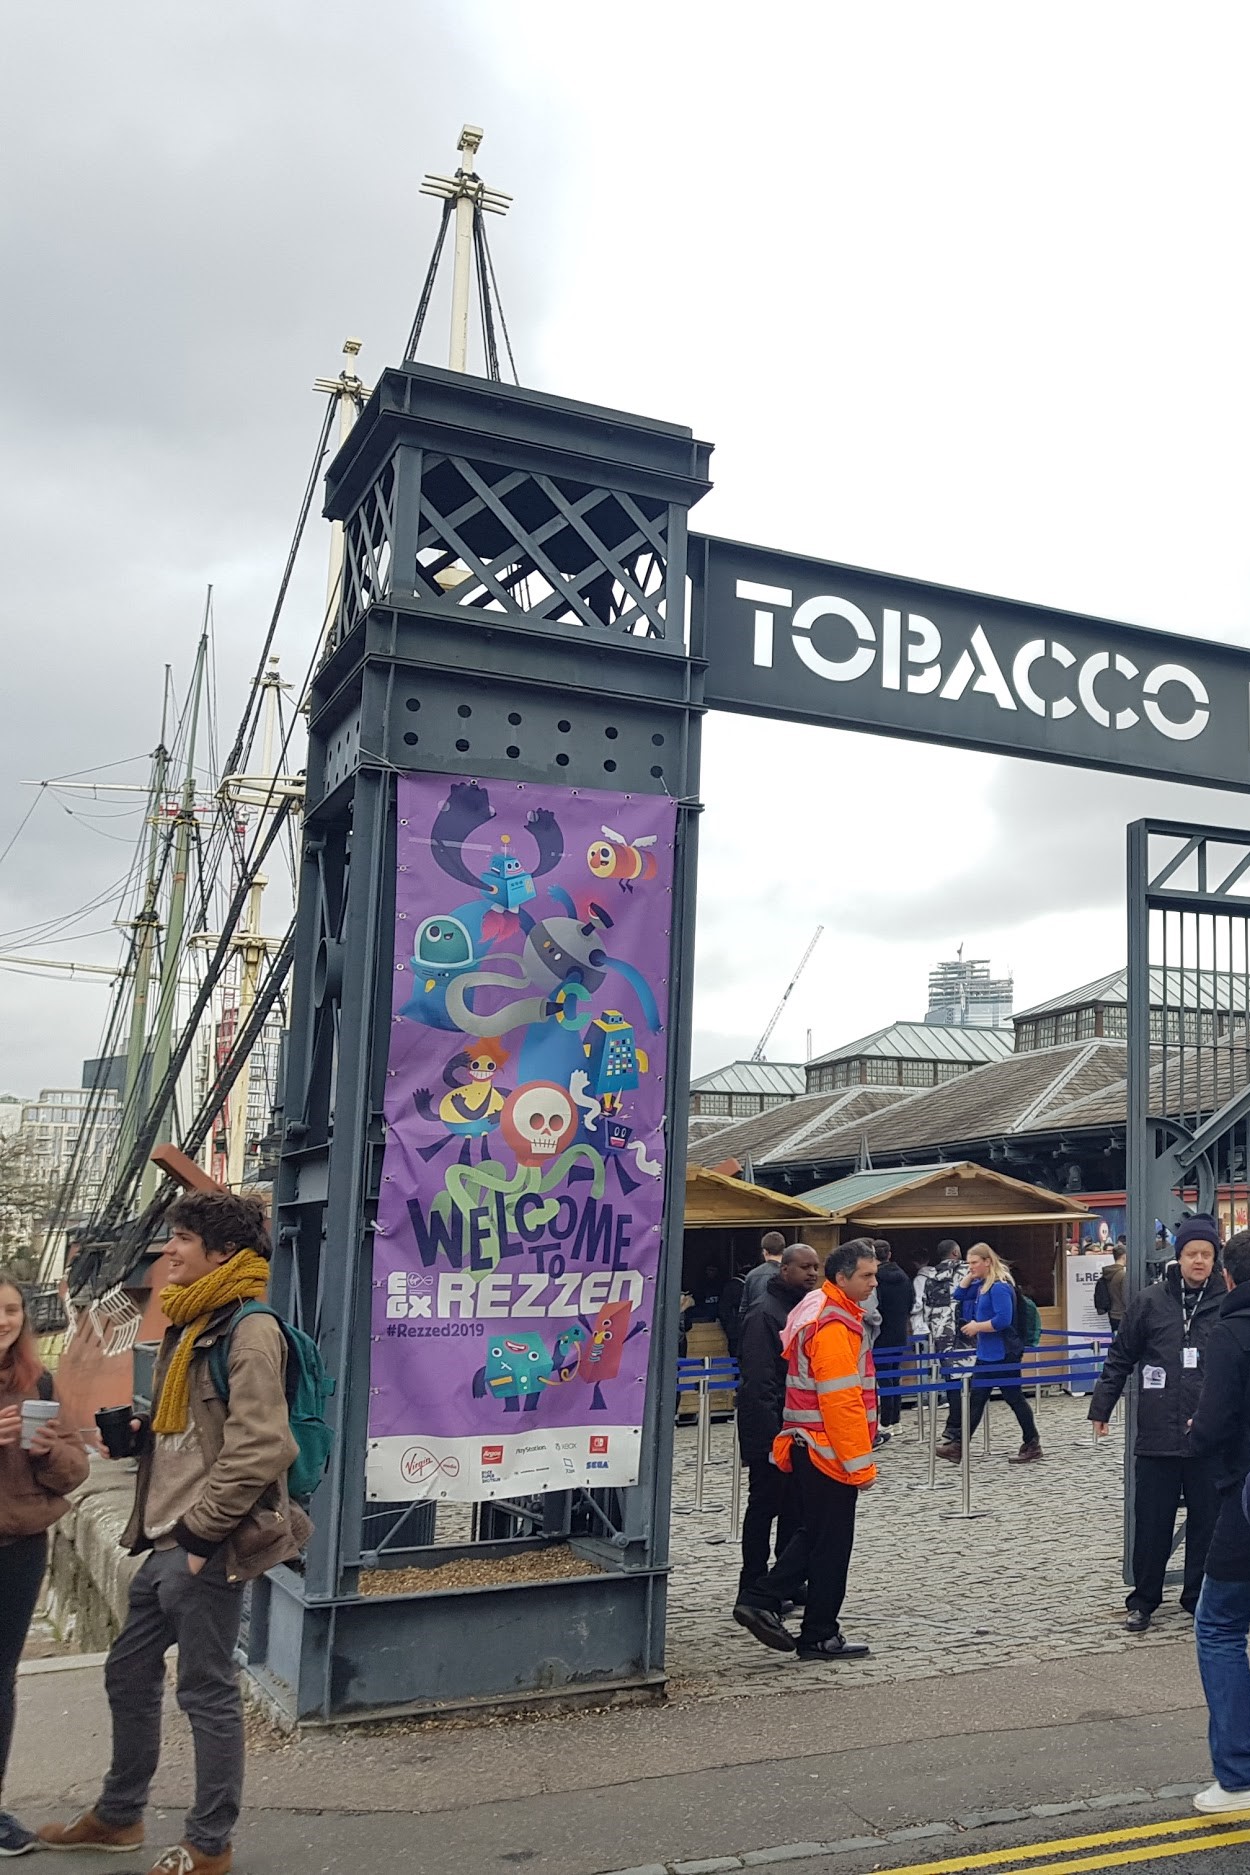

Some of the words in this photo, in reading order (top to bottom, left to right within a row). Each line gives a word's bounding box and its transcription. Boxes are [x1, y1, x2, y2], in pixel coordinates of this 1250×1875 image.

[735, 578, 1210, 741] TOBACCO
[406, 1190, 633, 1272] WELCOME
[528, 1242, 566, 1279] TO
[386, 1322, 485, 1339] #Rezzed2019
[404, 1452, 434, 1477] Virgin
[586, 1461, 609, 1469] SEGA
